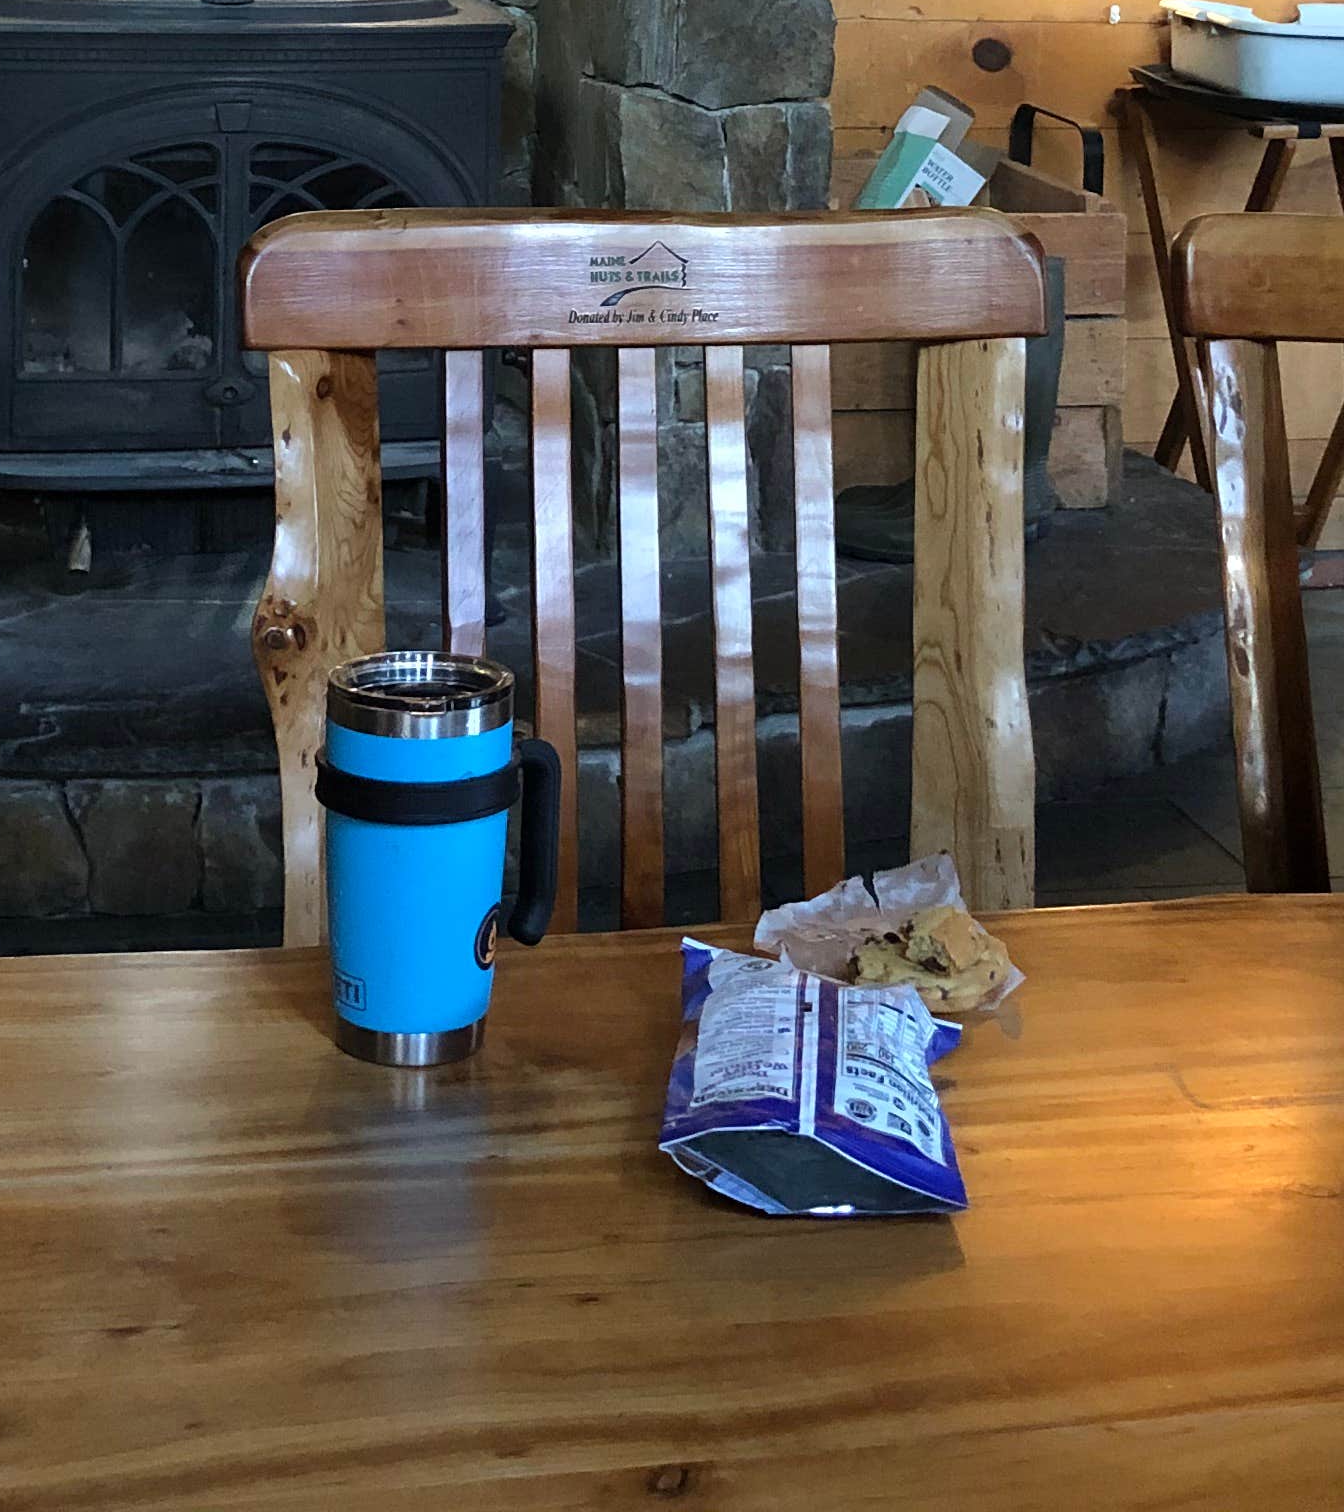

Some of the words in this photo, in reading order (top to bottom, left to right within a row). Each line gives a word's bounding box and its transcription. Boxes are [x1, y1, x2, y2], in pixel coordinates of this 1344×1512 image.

[921, 167, 953, 192] BOTTLE
[927, 159, 955, 183] WATER
[589, 256, 626, 267] MAINE
[590, 271, 622, 283] HUTS
[625, 271, 634, 282] &
[637, 270, 680, 282] TRAILS
[568, 310, 610, 324] Donated
[612, 310, 623, 326] by
[625, 309, 645, 324] Jim
[648, 309, 656, 323] &
[660, 309, 690, 326] Cindy
[691, 309, 720, 323] Place
[846, 1066, 885, 1084] Facts
[889, 1079, 935, 1126] Nutrition
